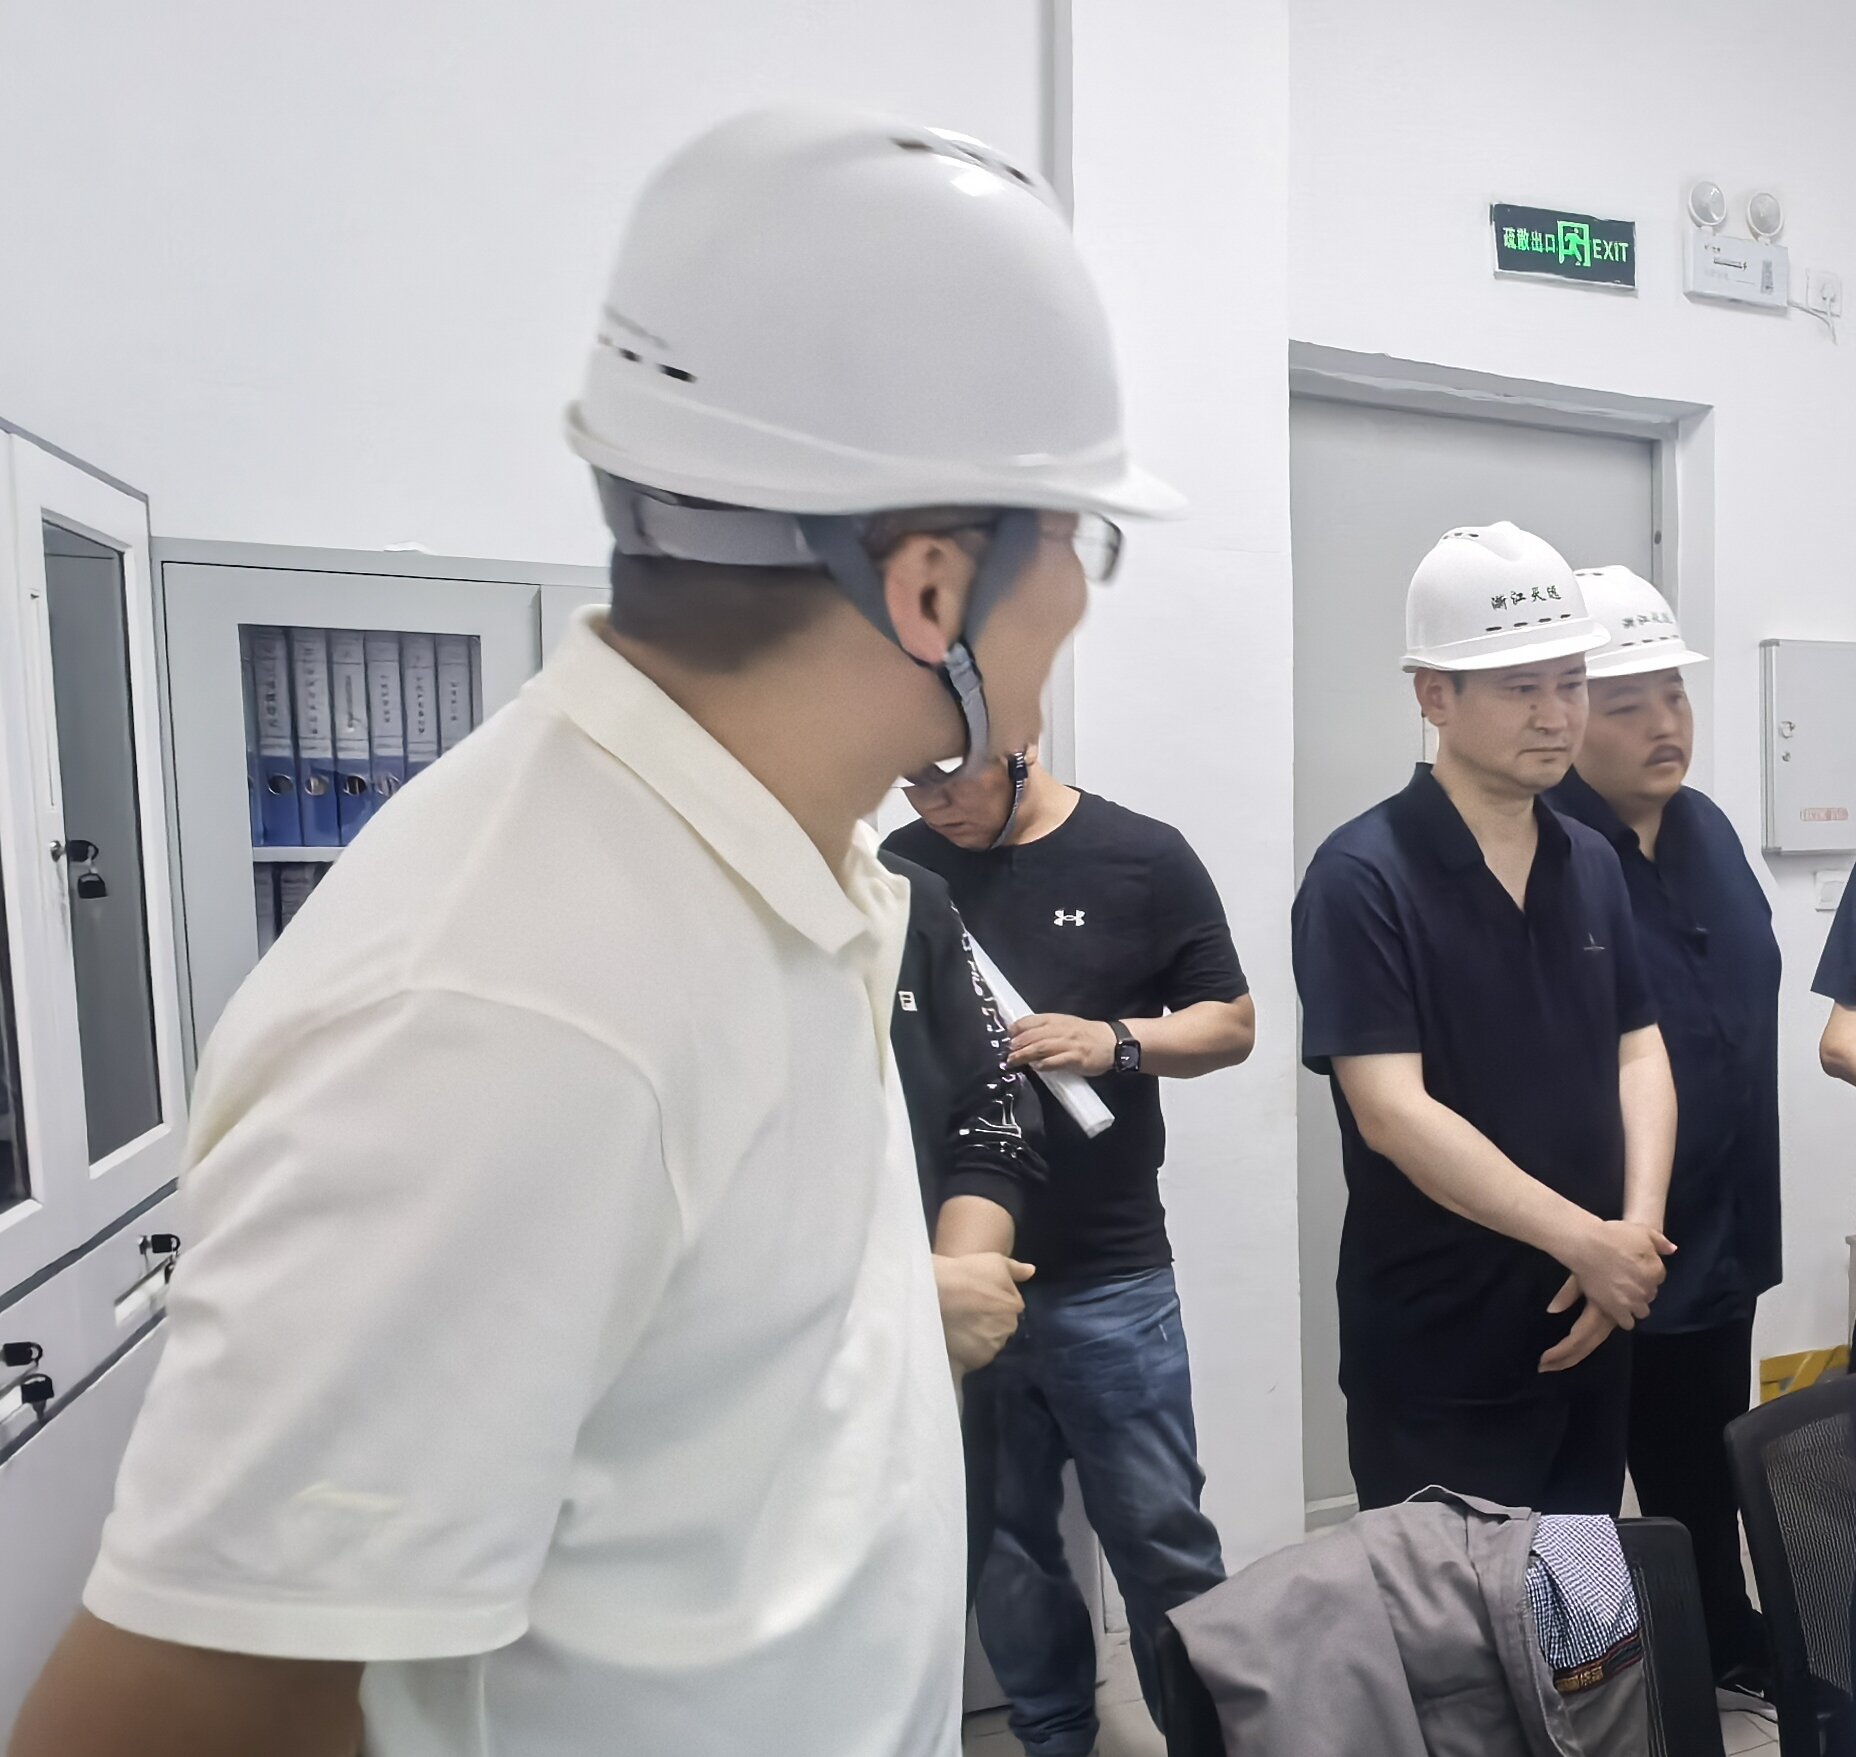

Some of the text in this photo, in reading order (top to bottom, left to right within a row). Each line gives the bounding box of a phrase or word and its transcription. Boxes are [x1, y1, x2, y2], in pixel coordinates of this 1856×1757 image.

[1503, 226, 1629, 262] 疏散出口 EXIT
